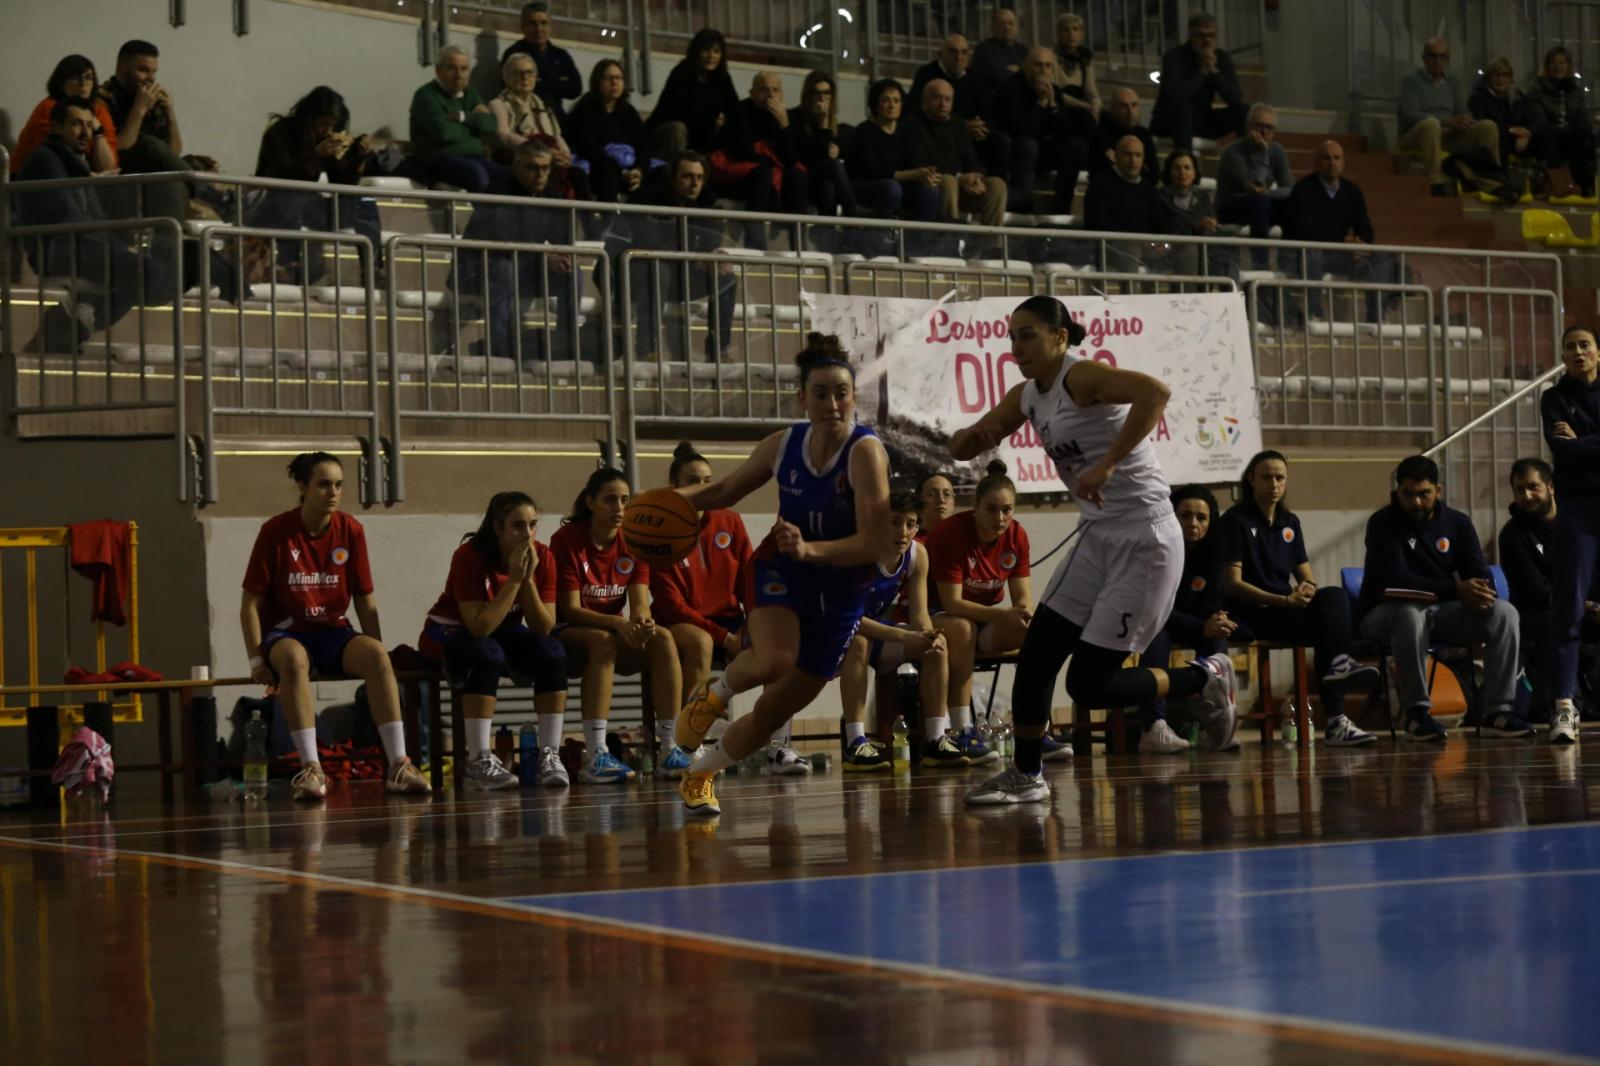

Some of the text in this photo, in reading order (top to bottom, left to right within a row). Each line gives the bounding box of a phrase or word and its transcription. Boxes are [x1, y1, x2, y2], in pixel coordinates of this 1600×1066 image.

[807, 509, 825, 538] 11
[288, 571, 340, 585] MiniMax
[1116, 612, 1132, 639] 5
